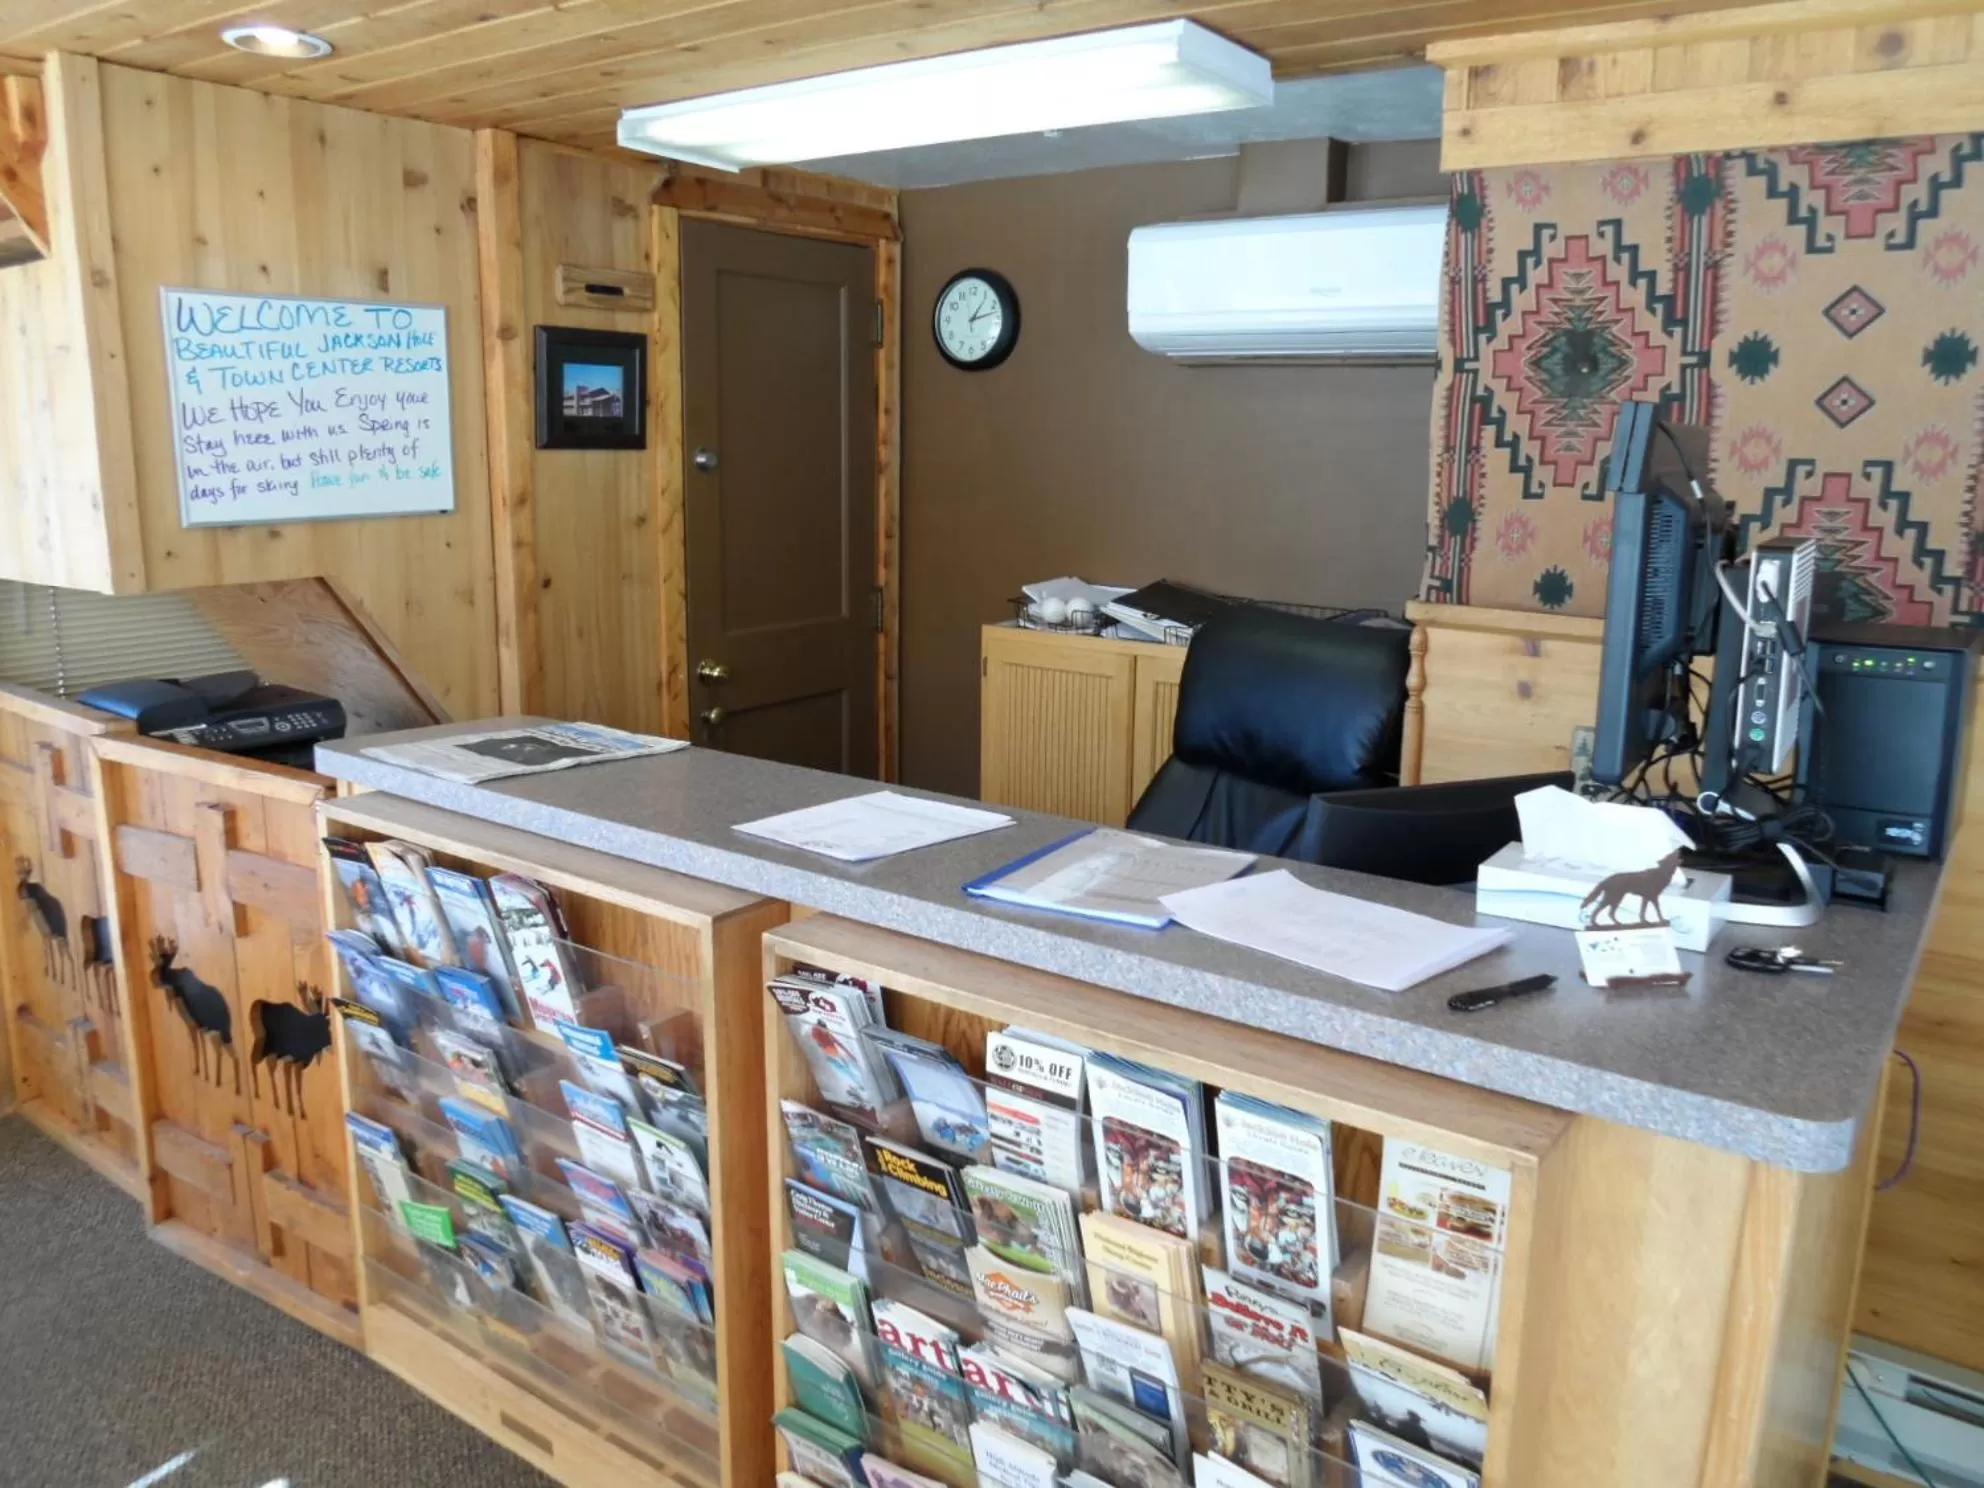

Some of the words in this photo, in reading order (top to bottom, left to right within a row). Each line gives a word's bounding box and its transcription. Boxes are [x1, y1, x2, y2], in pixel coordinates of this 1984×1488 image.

[176, 296, 352, 337] WELCOME
[363, 307, 413, 330] TO
[174, 336, 308, 361] BEAUTIFUL
[317, 331, 402, 353] JACKSON
[207, 365, 285, 391] TOWN
[291, 357, 374, 381] CENTER
[334, 387, 388, 412] Enjoy
[281, 425, 319, 442] with
[210, 457, 240, 475] the
[280, 451, 303, 471] but
[347, 442, 397, 468] plenty
[402, 438, 420, 461] of
[190, 483, 225, 505] days
[230, 477, 248, 502] for
[1019, 1053, 1045, 1074] 10%
[1048, 1061, 1074, 1081] OFF
[883, 1147, 917, 1174] Rock
[886, 1161, 949, 1199] Climbing
[877, 1318, 959, 1377] art
